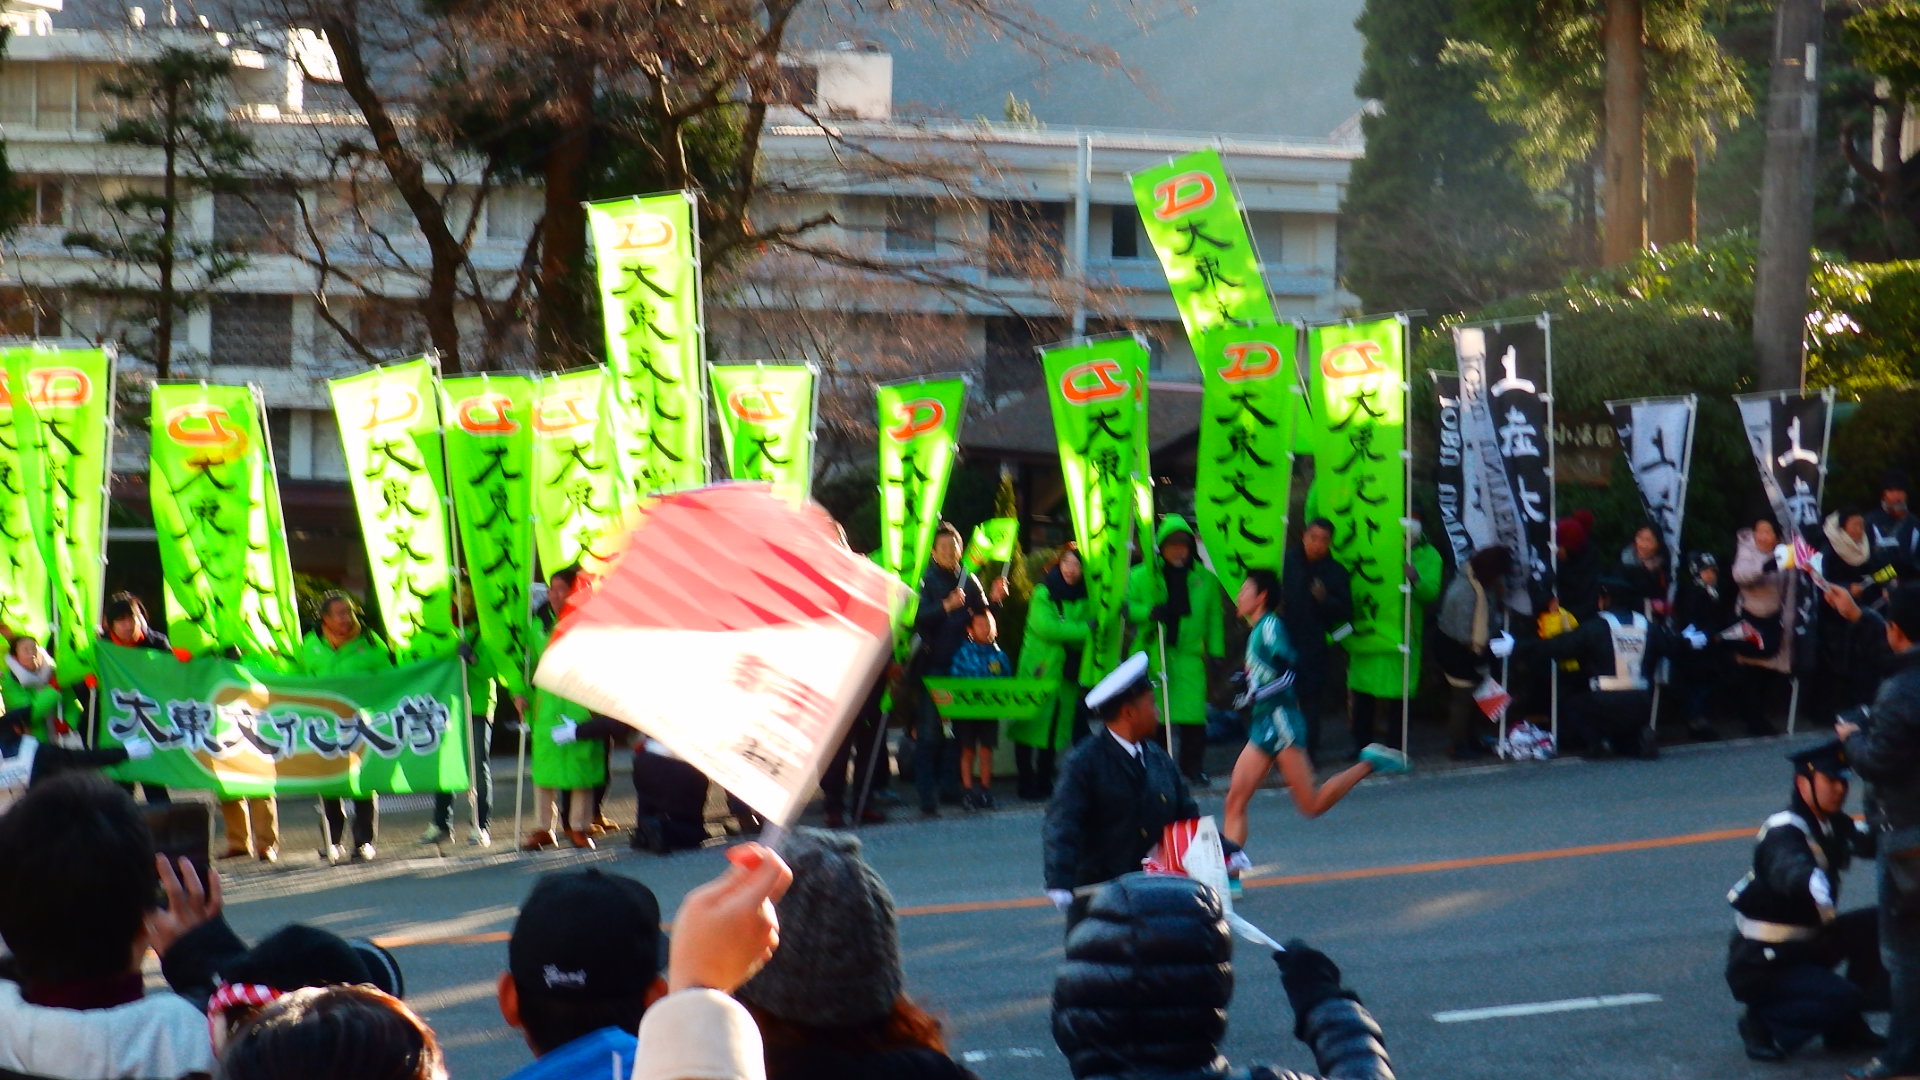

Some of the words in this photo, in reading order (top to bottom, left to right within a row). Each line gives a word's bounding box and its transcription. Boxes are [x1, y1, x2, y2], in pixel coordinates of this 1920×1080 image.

[107, 687, 452, 763] 大東文化大学
